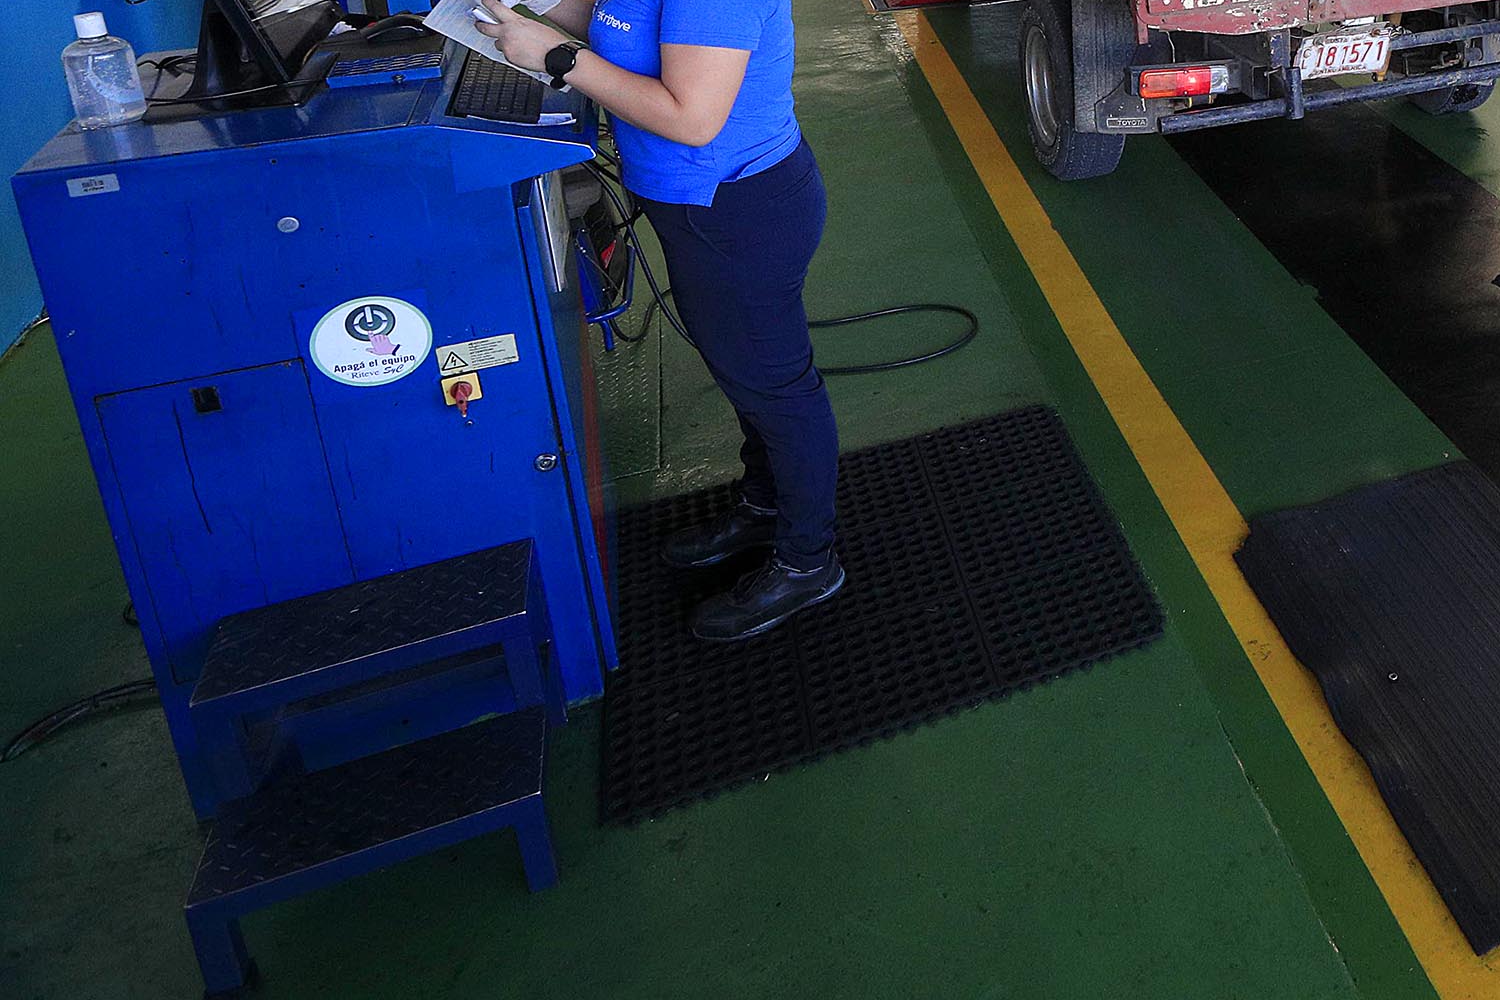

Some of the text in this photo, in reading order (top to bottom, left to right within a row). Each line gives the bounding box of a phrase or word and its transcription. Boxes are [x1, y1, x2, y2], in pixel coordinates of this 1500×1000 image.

[1316, 40, 1384, 68] 181571
[1117, 119, 1146, 127] TOYOTA
[334, 354, 415, 373] Apagá el equipo
